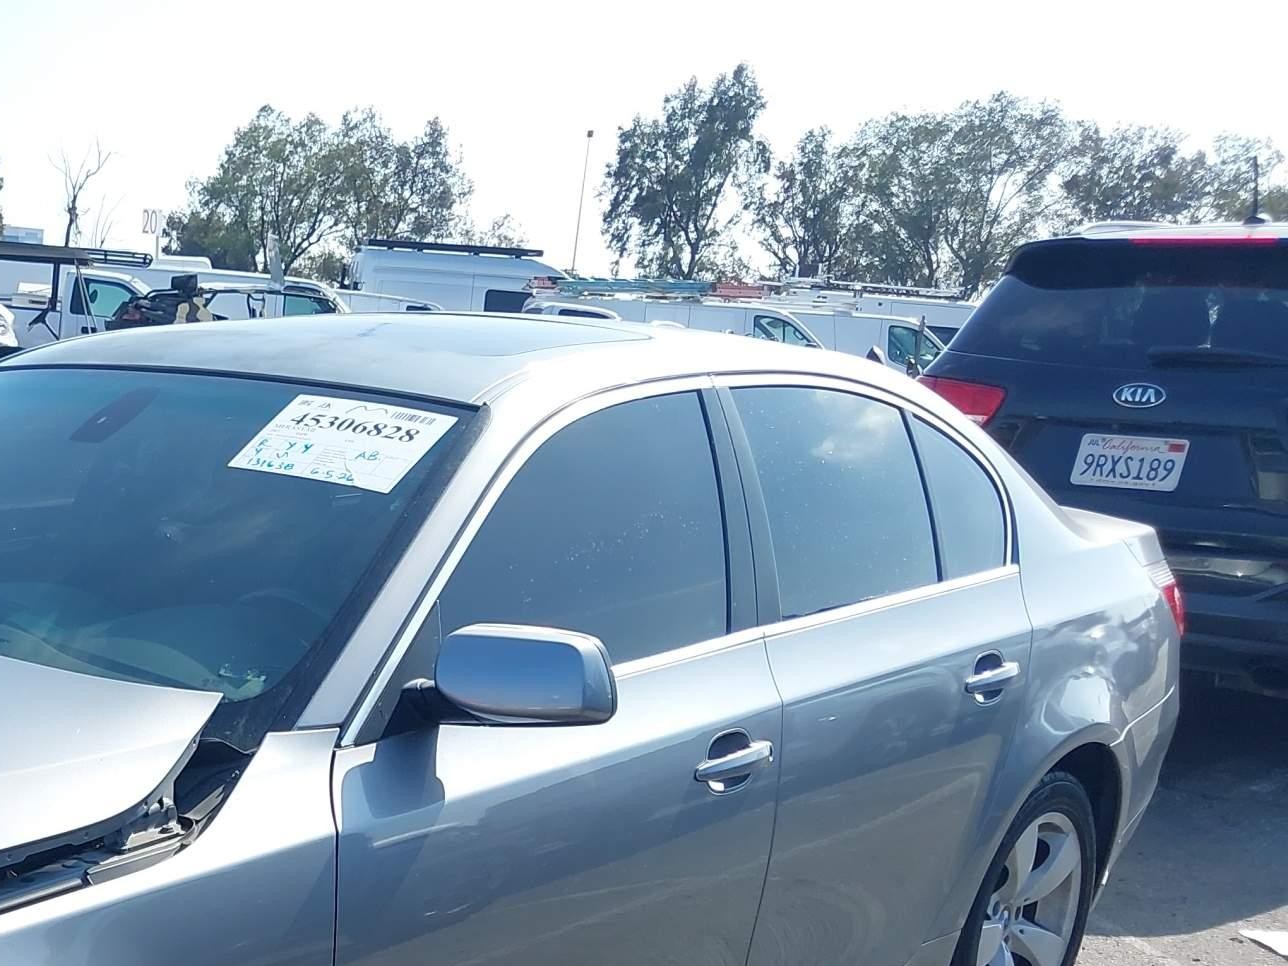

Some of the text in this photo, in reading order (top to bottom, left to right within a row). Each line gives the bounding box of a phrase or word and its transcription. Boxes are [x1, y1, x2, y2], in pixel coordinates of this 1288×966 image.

[142, 209, 158, 234] 20
[1121, 387, 1156, 402] KIA
[290, 412, 420, 443] 45306828
[1102, 438, 1163, 454] California
[1079, 453, 1176, 482] 9RXS189
